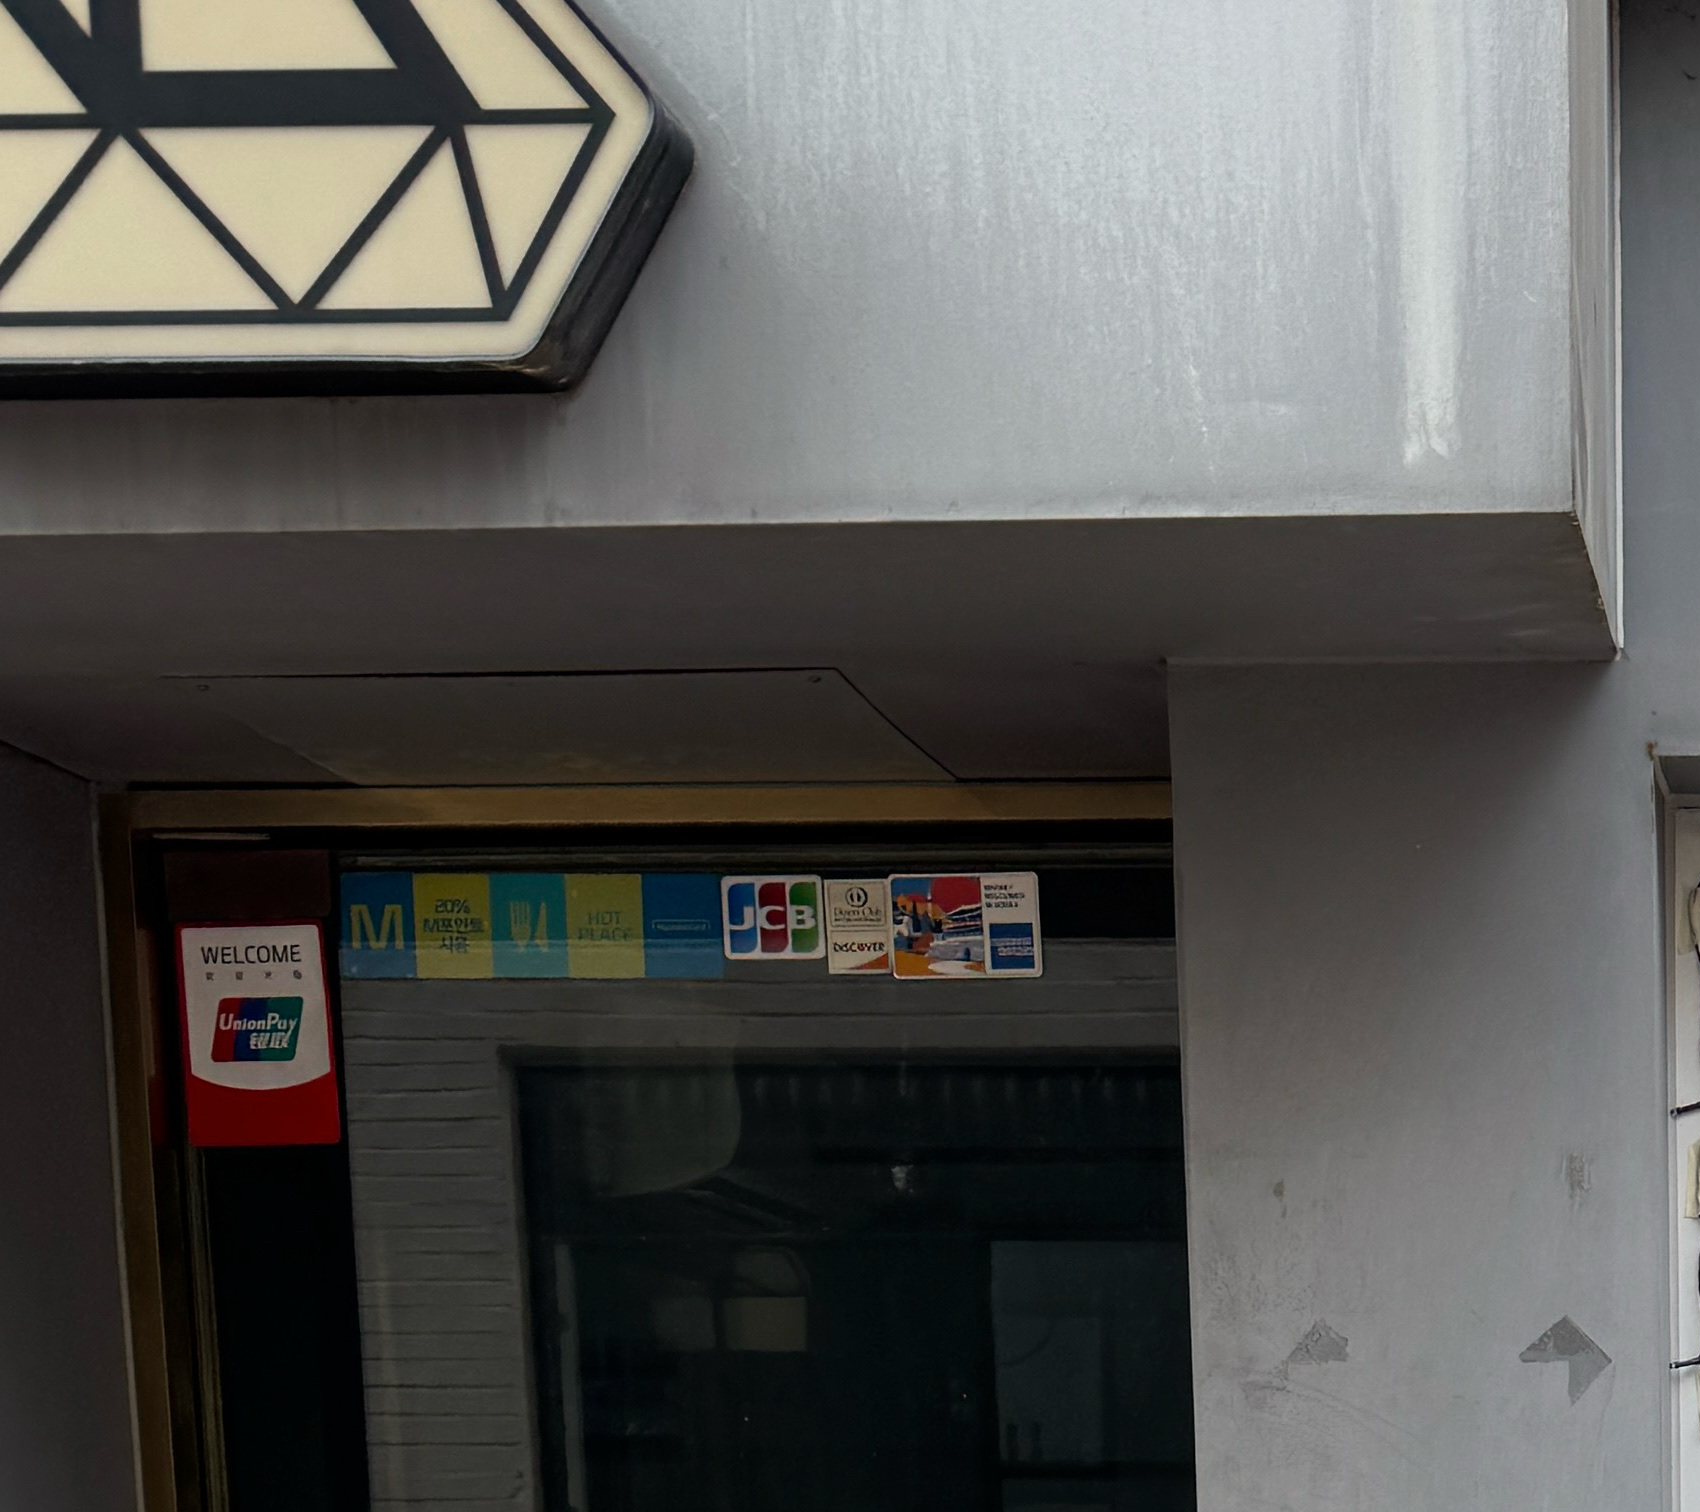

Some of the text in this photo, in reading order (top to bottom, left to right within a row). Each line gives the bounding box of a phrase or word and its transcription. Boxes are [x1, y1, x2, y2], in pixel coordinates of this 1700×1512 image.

[435, 899, 470, 914] 20%
[350, 903, 404, 950] M
[587, 911, 622, 927] HOT
[729, 905, 817, 930] JCB
[577, 927, 634, 943] PLACE
[200, 944, 302, 964] WELCOME
[833, 941, 885, 953] DISCOVER
[219, 1012, 298, 1038] UnionPay
